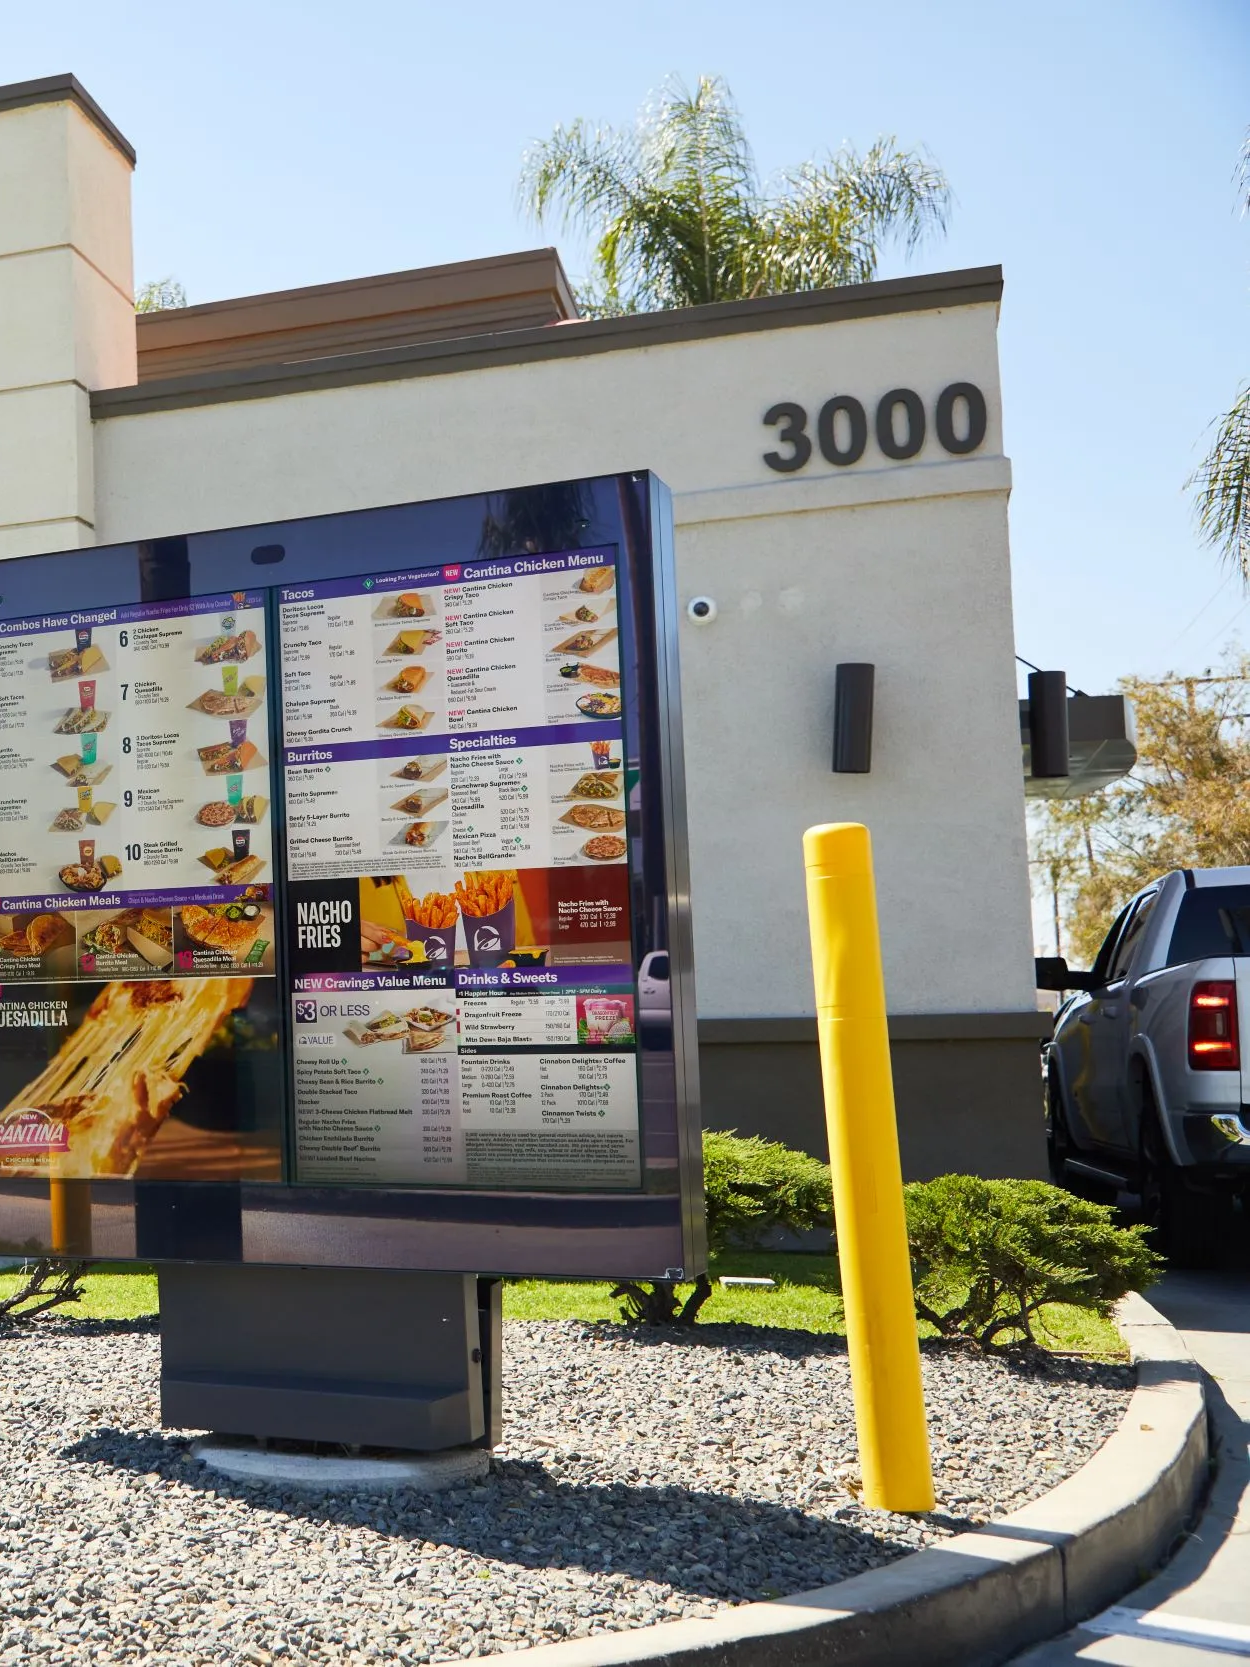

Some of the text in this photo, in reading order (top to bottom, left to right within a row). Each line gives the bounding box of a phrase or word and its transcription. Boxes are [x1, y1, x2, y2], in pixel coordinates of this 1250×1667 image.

[762, 382, 988, 473] 3000
[445, 554, 604, 579] NEW Cantina Chicken Menu
[375, 576, 397, 584] Looking
[281, 588, 315, 601] Tacos
[443, 581, 513, 595] NEW! Cantina Chicken
[42, 617, 68, 628] Have
[70, 609, 117, 625] Changed
[463, 612, 488, 620] Cantina
[488, 609, 514, 617] Chicken
[119, 630, 129, 648] 6
[283, 641, 307, 649] Crunchy
[489, 636, 515, 644] Chicken
[465, 666, 489, 674] Cantina
[490, 663, 516, 671] Chicken
[447, 673, 480, 682] Quesadilla
[120, 683, 129, 701] 7
[285, 698, 336, 709] Chalupa Supreme
[448, 705, 518, 717] NEW! Cantina Chicken
[122, 737, 131, 754] 8
[449, 734, 517, 752] Specialties
[287, 750, 333, 762] Burritos
[450, 755, 470, 763] Nacho
[123, 790, 133, 808] 9
[451, 803, 485, 811] Quesadilla
[124, 843, 141, 861] 10
[2, 898, 42, 910] Cantina
[44, 897, 87, 909] Chicken
[89, 894, 121, 906] Meals
[297, 900, 352, 925] NACHO
[298, 924, 341, 949] FRIES
[294, 975, 447, 991] NEW Cravings Value Menu
[458, 972, 558, 985] Drinks & Sweets
[28, 1001, 68, 1010] CHICKEN
[297, 1001, 370, 1021] $3 OR LESS
[308, 1036, 334, 1045] VALUE
